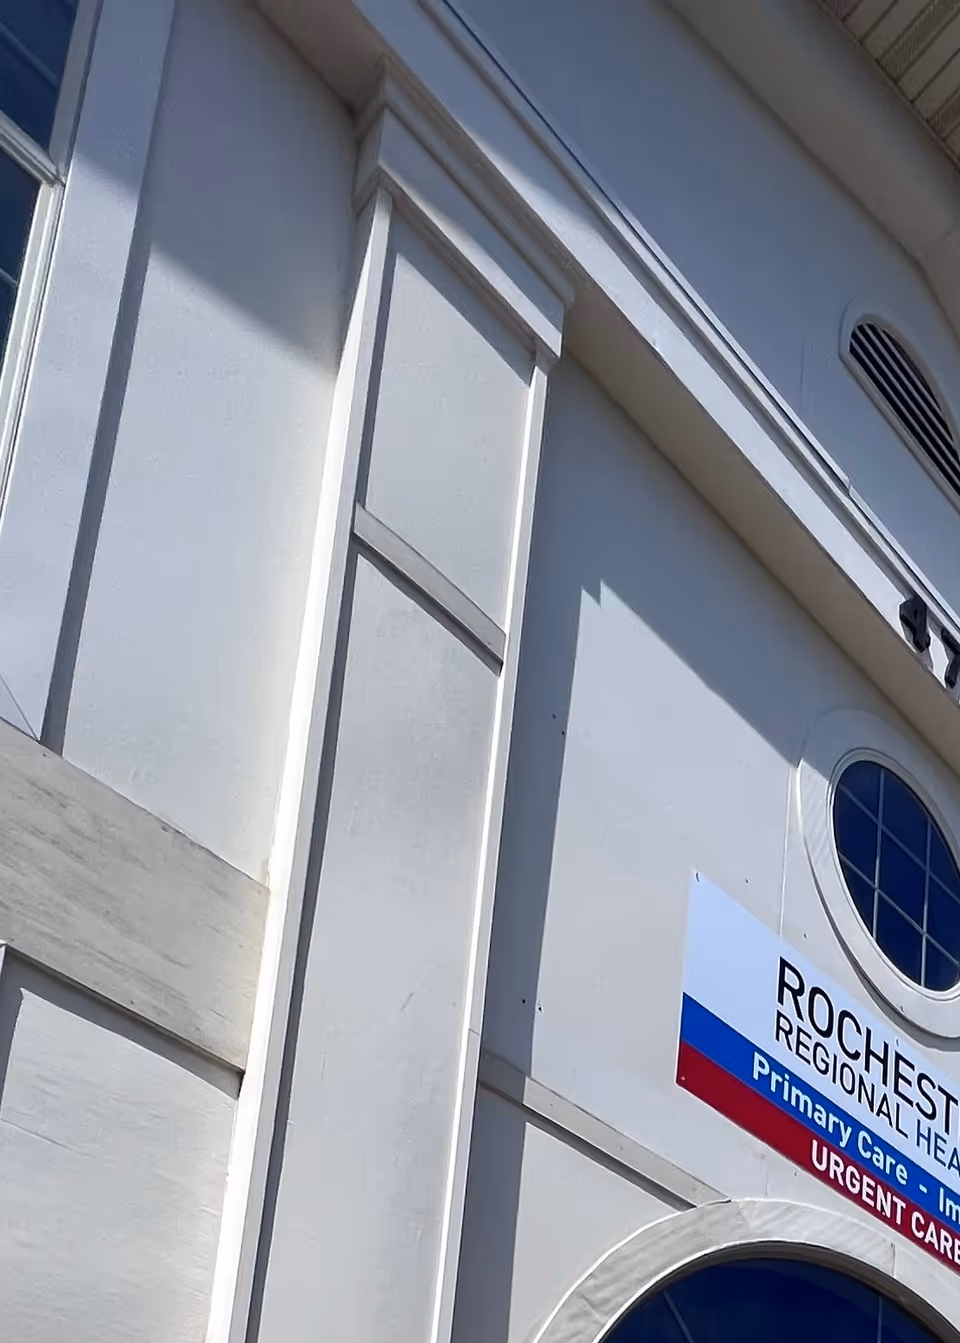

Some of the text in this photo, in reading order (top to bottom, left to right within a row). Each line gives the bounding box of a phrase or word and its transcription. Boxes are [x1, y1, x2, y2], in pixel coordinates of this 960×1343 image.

[752, 1051, 852, 1148] Primary
[857, 1130, 909, 1186] Care
[919, 1184, 928, 1194] -
[775, 1009, 909, 1139] REGIONAL
[811, 1139, 906, 1226] URGENT
